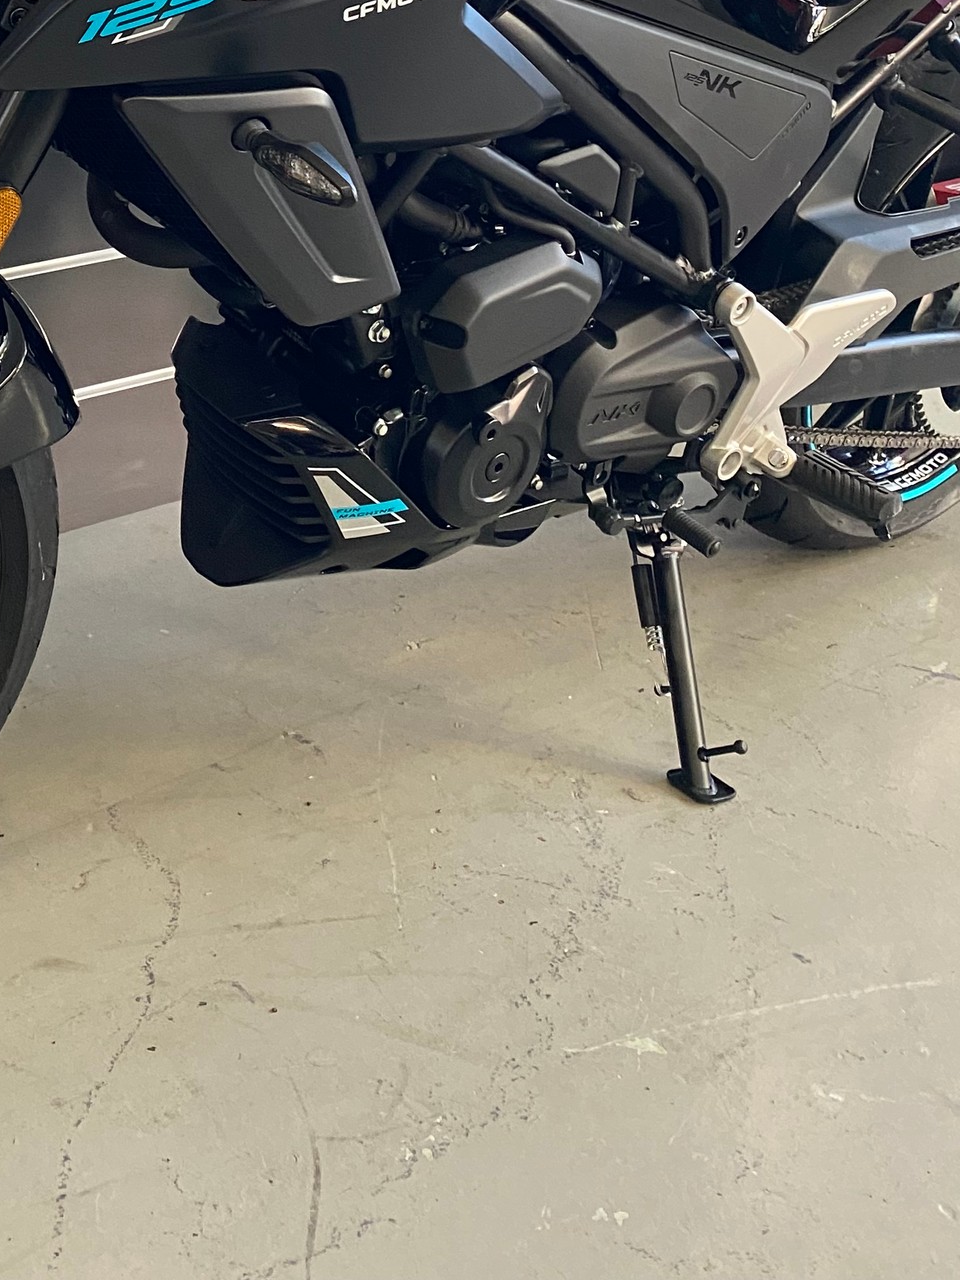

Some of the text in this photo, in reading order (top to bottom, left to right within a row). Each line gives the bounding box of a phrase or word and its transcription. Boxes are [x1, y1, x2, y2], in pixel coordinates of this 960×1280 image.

[684, 68, 742, 99] 125 NK
[896, 452, 949, 488] CFMOTO
[338, 507, 394, 518] MACHINE
